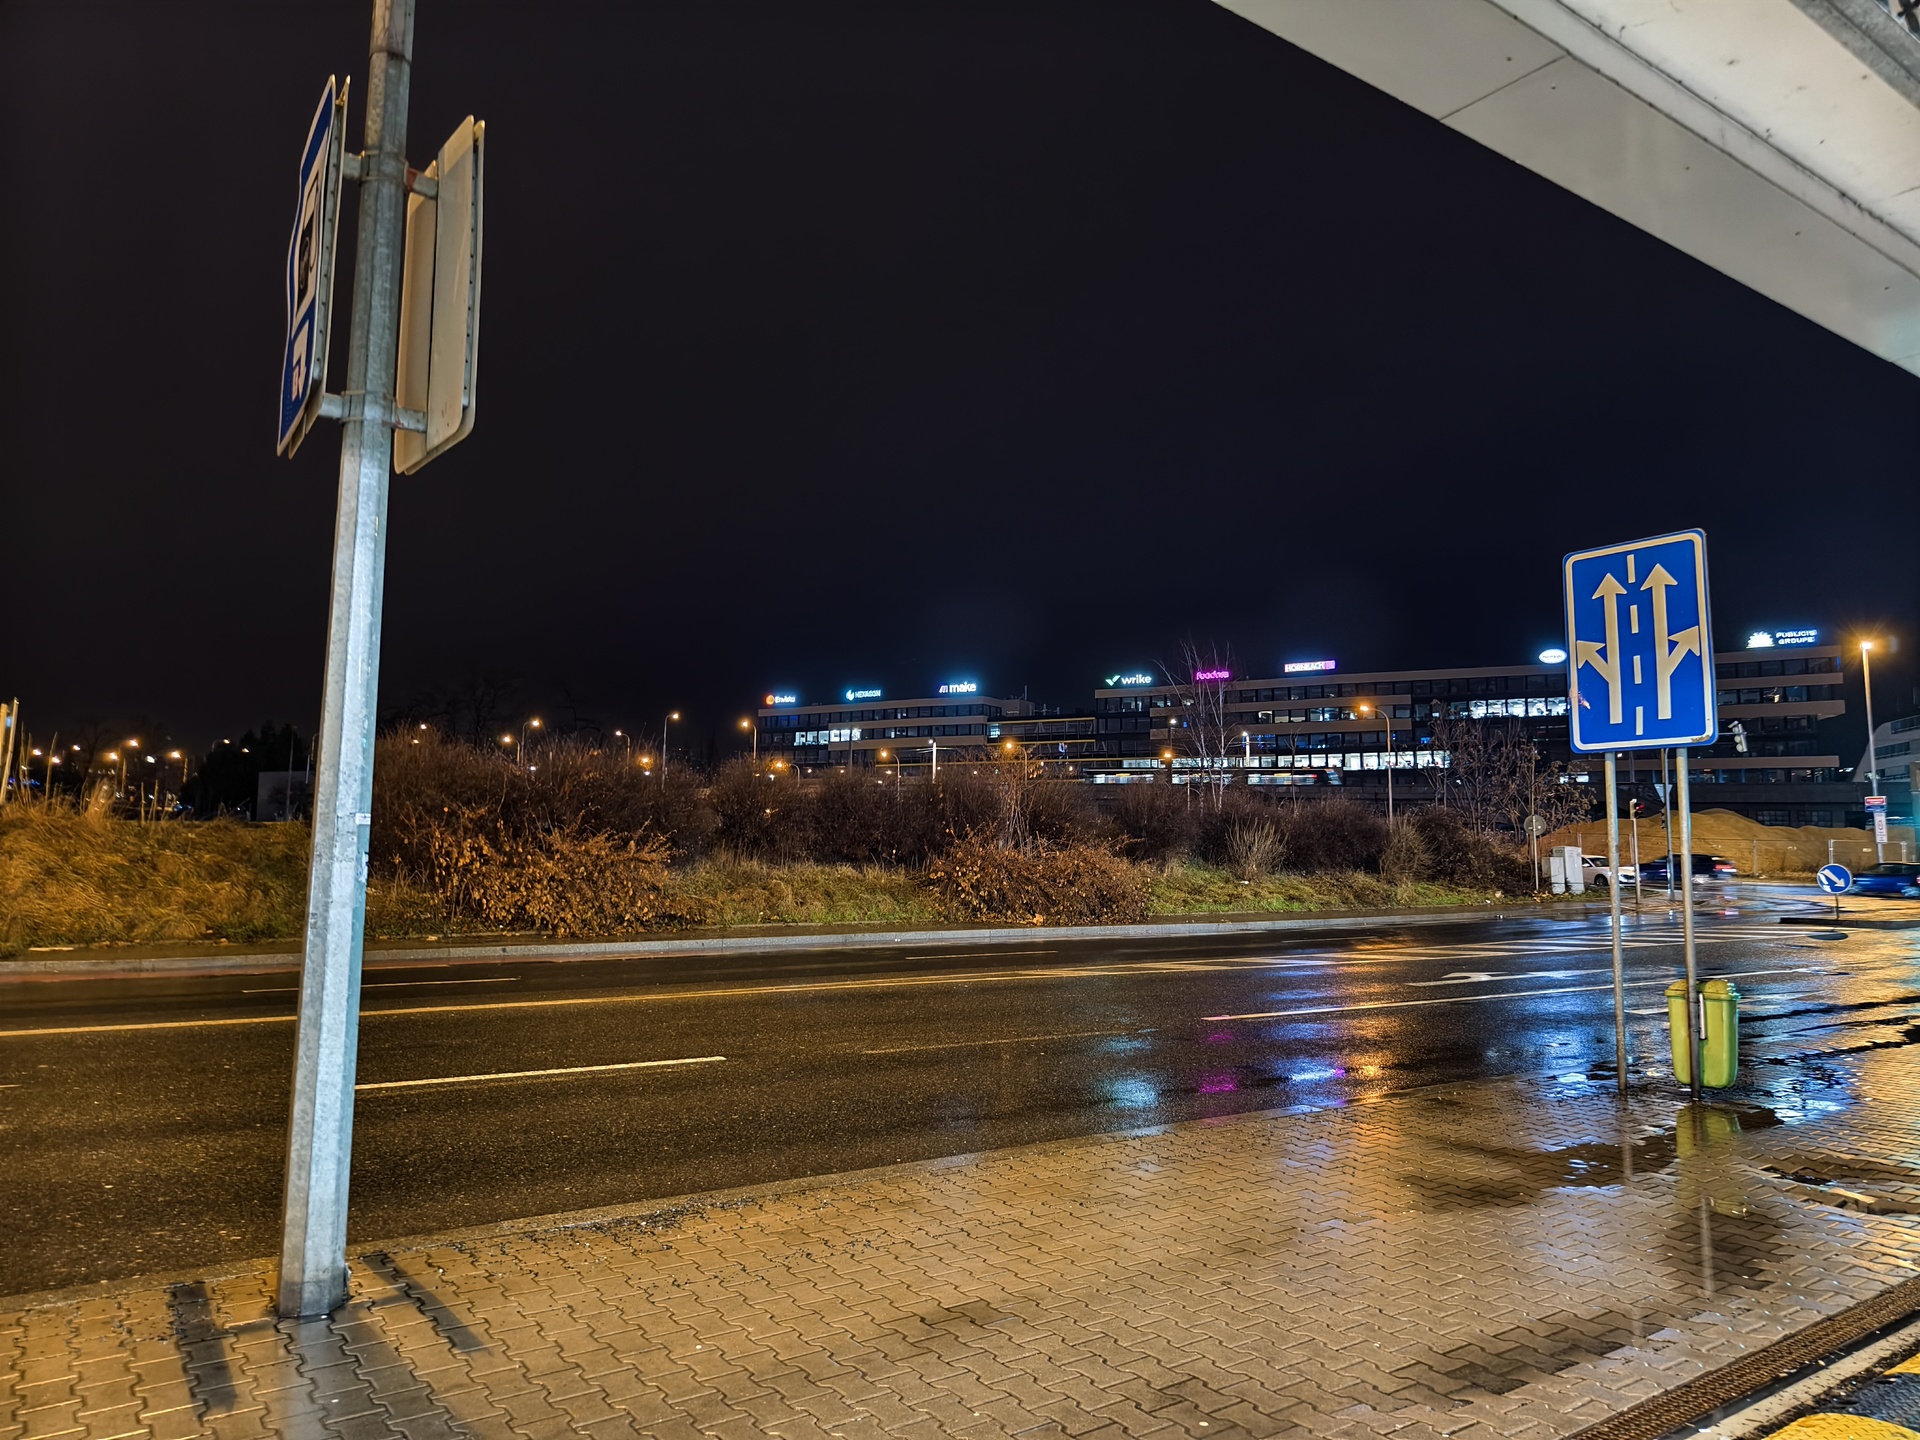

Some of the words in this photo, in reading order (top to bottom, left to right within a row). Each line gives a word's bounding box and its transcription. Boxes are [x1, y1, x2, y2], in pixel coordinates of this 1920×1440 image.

[1778, 637, 1815, 645] GROUPE
[1121, 674, 1152, 685] wrike
[949, 681, 977, 694] make
